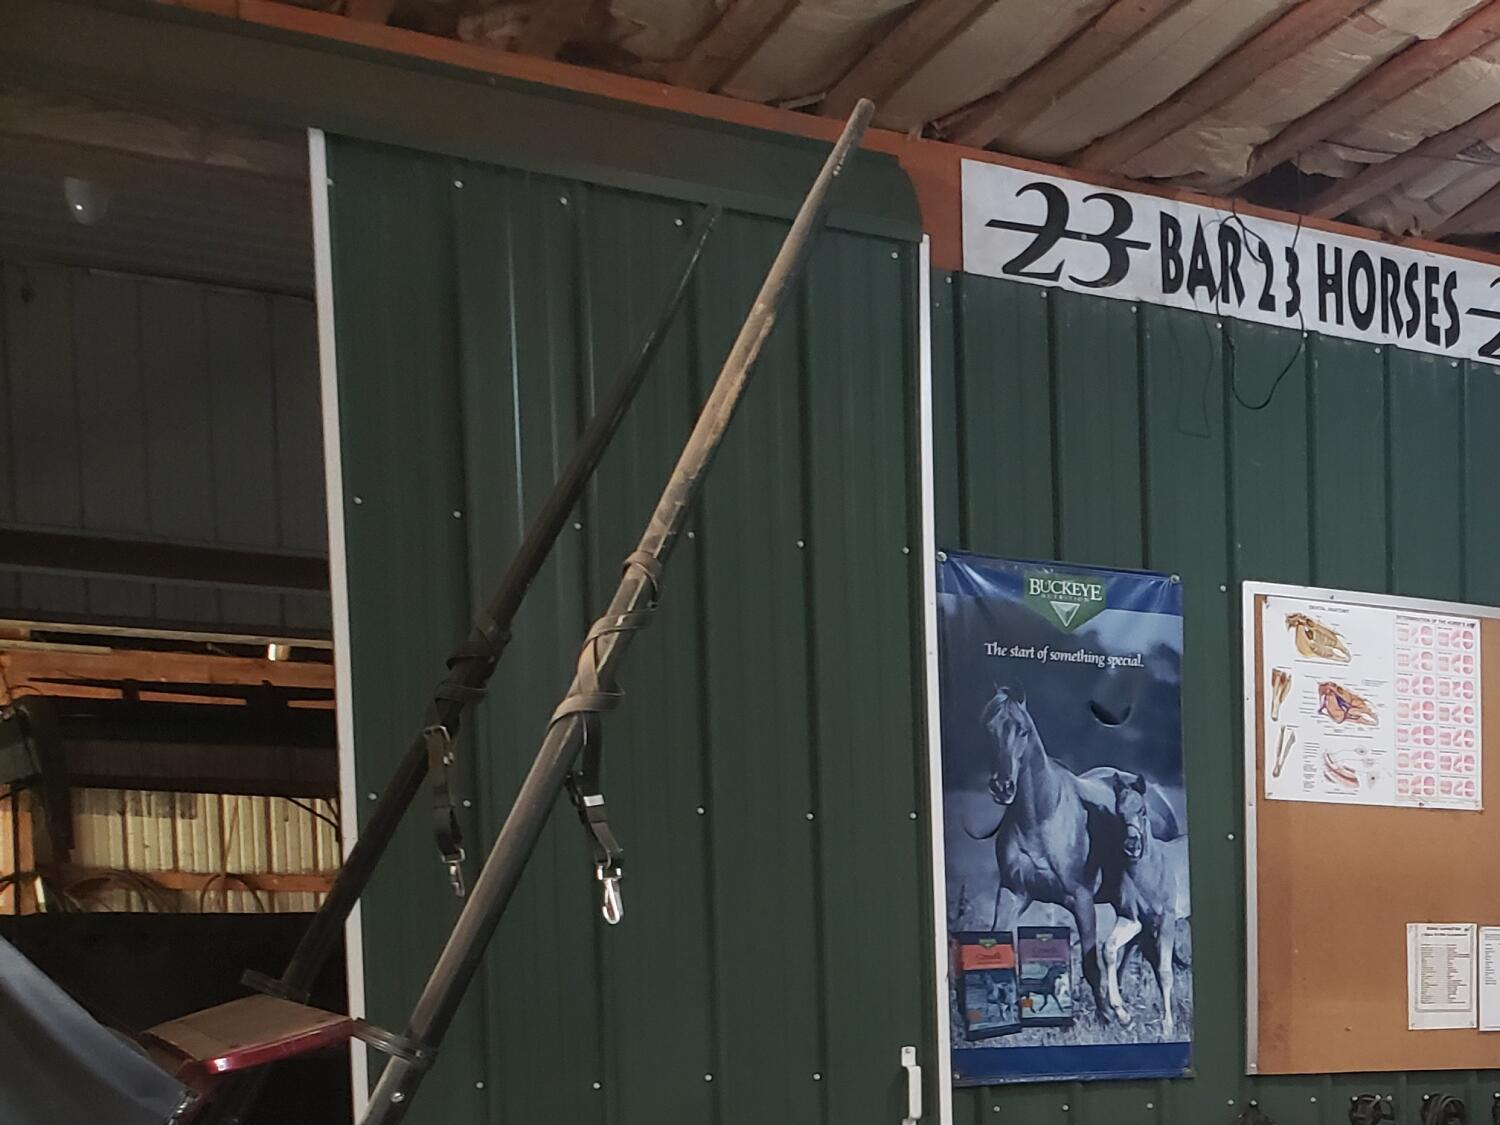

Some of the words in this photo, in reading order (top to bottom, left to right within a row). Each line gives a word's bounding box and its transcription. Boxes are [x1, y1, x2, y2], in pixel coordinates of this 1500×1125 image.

[985, 181, 1152, 289] 23
[1159, 210, 1246, 308] BAR
[1257, 240, 1301, 318] 23
[1316, 243, 1461, 349] HORSES
[1028, 577, 1103, 602] BUCKEYE
[984, 641, 1007, 657] The
[1010, 645, 1036, 660] start
[1037, 646, 1050, 663] of
[1050, 648, 1106, 668] something
[1107, 653, 1145, 669] special.
